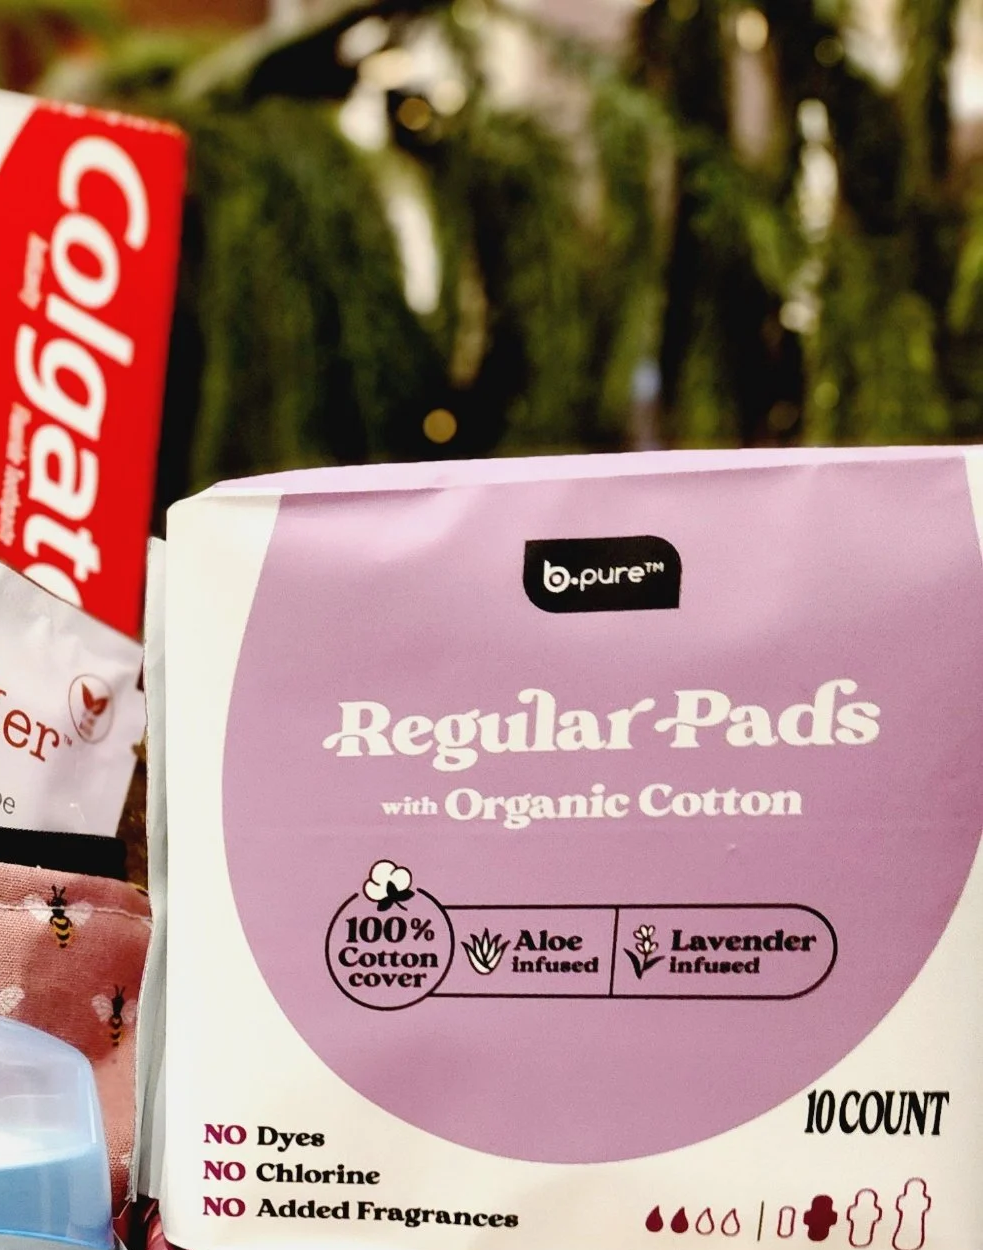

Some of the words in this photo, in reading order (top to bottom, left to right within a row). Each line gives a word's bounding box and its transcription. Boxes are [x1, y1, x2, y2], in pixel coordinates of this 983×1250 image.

[321, 687, 658, 773] Regular
[654, 678, 882, 749] Pads
[381, 795, 438, 818] with
[444, 784, 630, 830] Organic
[637, 783, 803, 819] Cotton
[345, 916, 435, 943] 100%
[513, 929, 584, 953] Aloe
[669, 929, 817, 954] Lavender
[338, 946, 439, 971] Cotton
[511, 955, 600, 976] infused
[668, 955, 761, 976] infused
[348, 968, 428, 990] cover
[804, 1091, 834, 1136] 10
[839, 1090, 950, 1137] COUNT
[203, 1123, 247, 1146] NO
[256, 1125, 326, 1152] Dyes
[203, 1160, 247, 1183] NO
[255, 1162, 381, 1186] Chlorine
[202, 1197, 246, 1219] NO
[256, 1198, 352, 1222] Added
[356, 1202, 520, 1231] Fragrances
